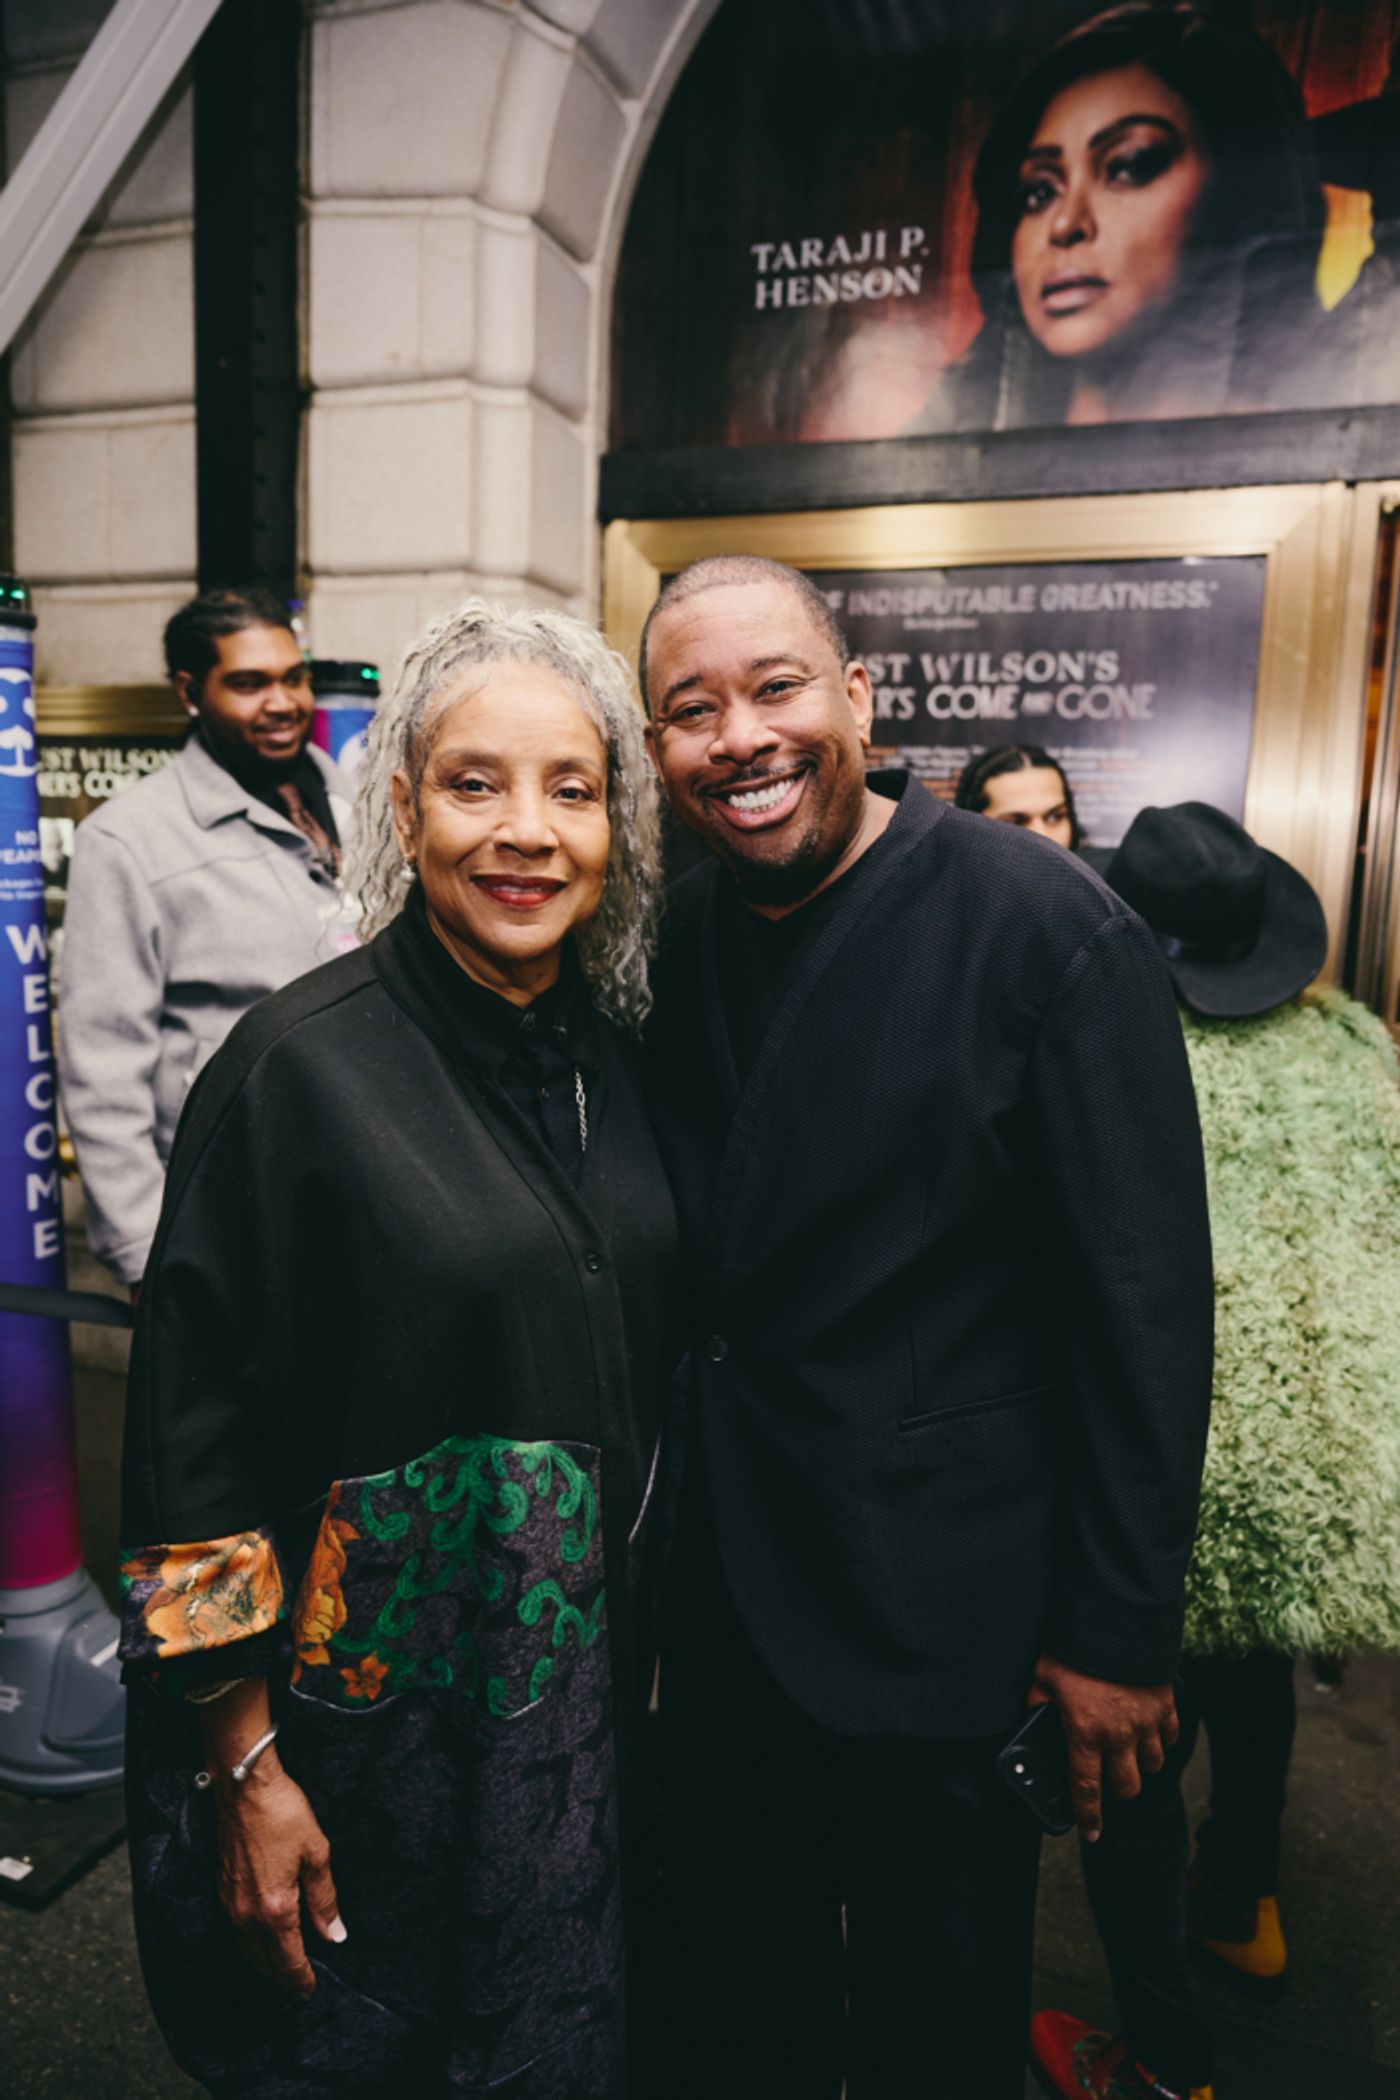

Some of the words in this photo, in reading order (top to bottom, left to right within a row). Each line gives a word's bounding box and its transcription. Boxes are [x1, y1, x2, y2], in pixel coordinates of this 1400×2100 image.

[751, 229, 888, 273] TARAJI
[900, 226, 929, 258] P.
[755, 264, 922, 309] HENSON
[855, 652, 911, 683] ST
[920, 650, 1120, 683] WILSON'S
[926, 683, 1020, 720] COME
[5, 923, 60, 1261] WELCOME
